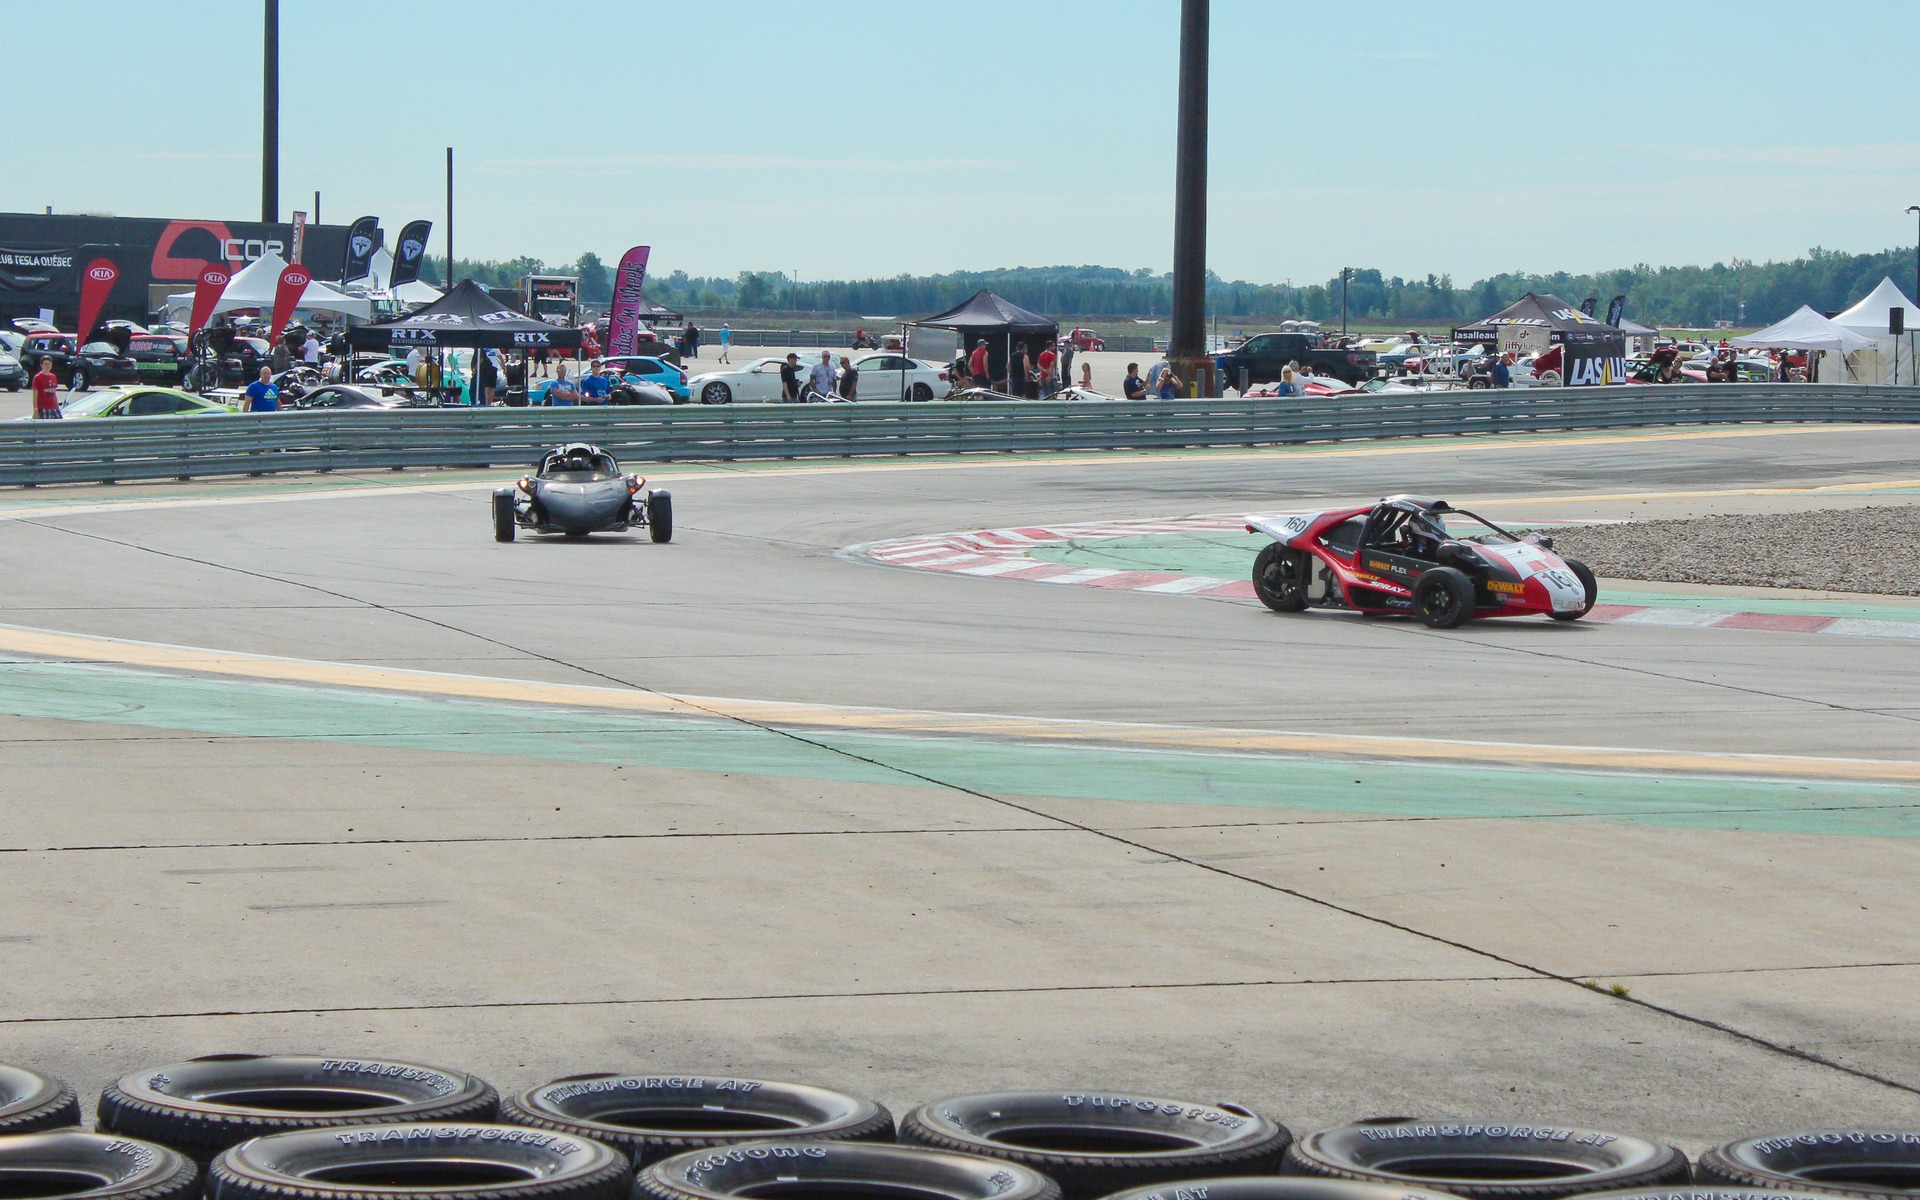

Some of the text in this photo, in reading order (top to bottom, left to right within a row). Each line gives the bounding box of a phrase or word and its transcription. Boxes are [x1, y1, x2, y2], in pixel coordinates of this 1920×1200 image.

[14, 255, 40, 266] TESLA
[40, 254, 72, 267] QUÉBEC
[94, 269, 111, 278] KIA
[207, 273, 223, 283] KIA
[285, 274, 302, 283] KIA
[617, 262, 644, 303] Wheels
[403, 313, 468, 324] RTX
[615, 306, 637, 325] On
[391, 328, 436, 339] RTX
[514, 332, 550, 342] RTX
[1283, 516, 1307, 533] 160
[1390, 565, 1408, 575] FLEX
[1541, 567, 1584, 590] 160
[1369, 580, 1406, 593] SPRAY
[543, 1076, 762, 1105] TRANSFORCE AT
[1063, 1094, 1247, 1129] Firestone
[335, 1127, 582, 1156] TRANSFORCE AT
[1359, 1124, 1618, 1147] TRANSFORCE AT
[1752, 1132, 1920, 1154] Fireston
